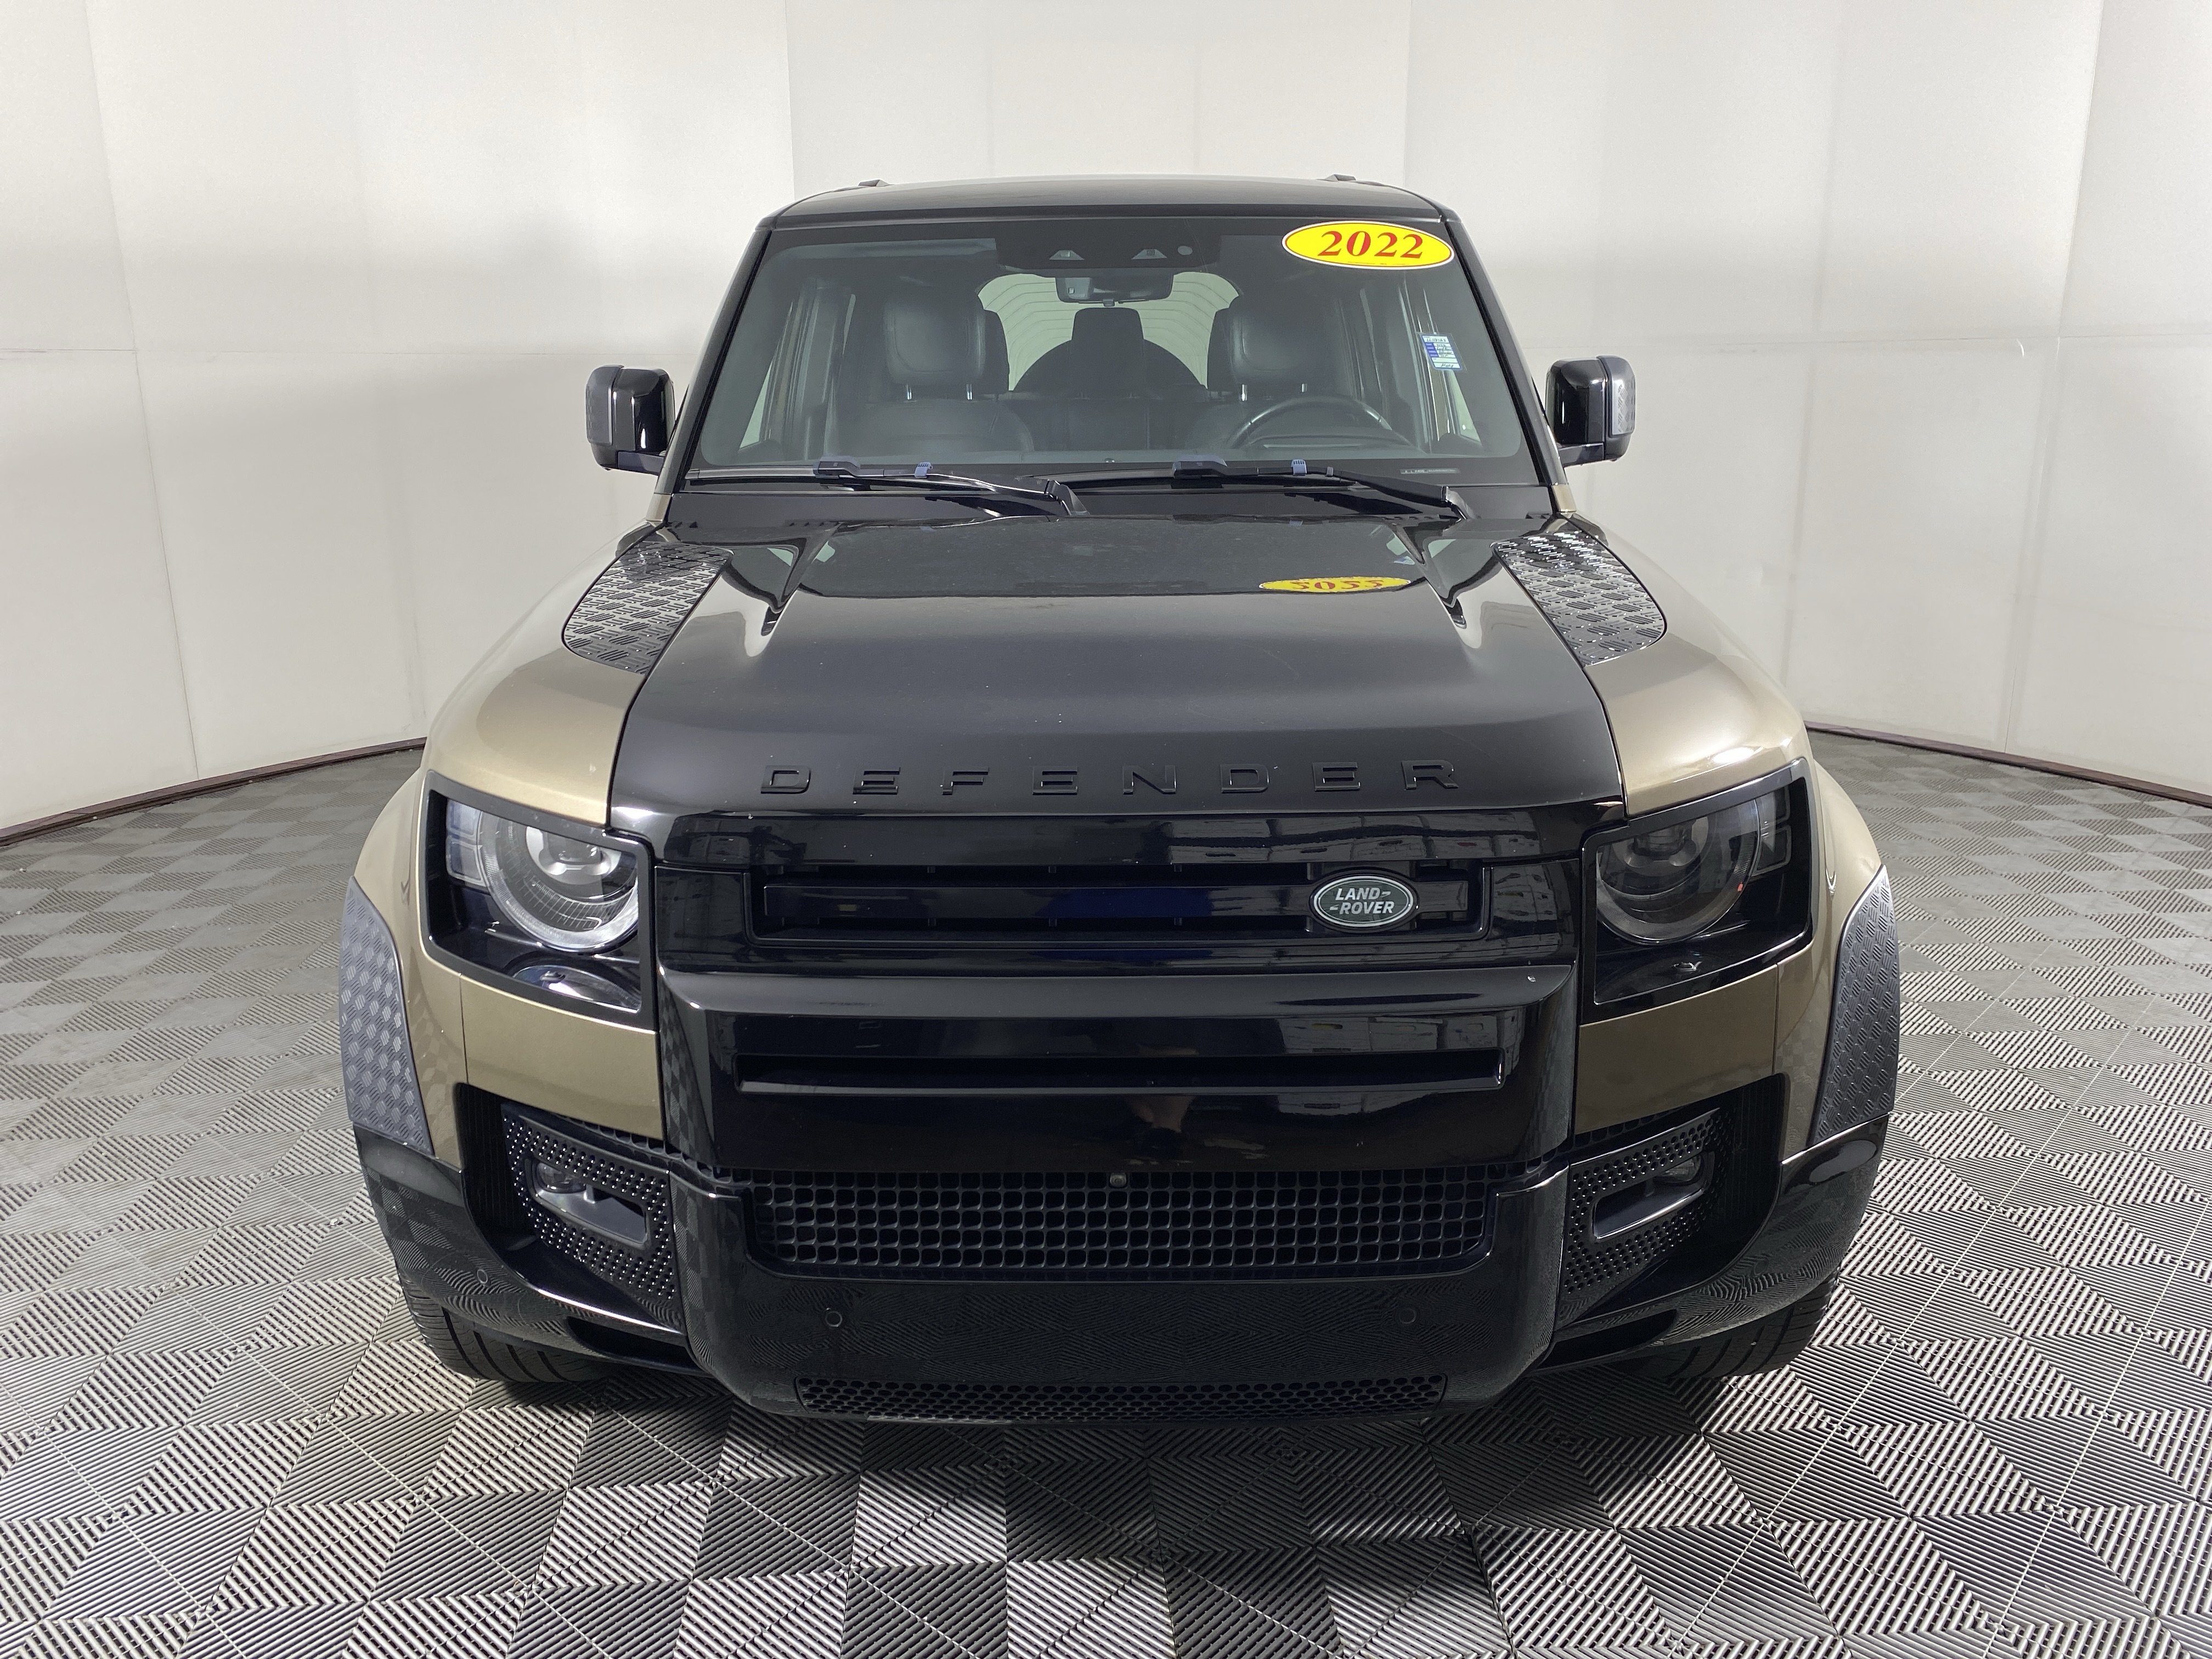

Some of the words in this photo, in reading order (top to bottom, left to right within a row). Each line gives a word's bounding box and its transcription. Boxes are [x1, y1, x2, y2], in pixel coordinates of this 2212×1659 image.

[1317, 230, 1423, 259] 2022
[760, 760, 1459, 795] DEFENDER
[1335, 887, 1381, 901] LAND
[1339, 901, 1395, 915] ROVER
